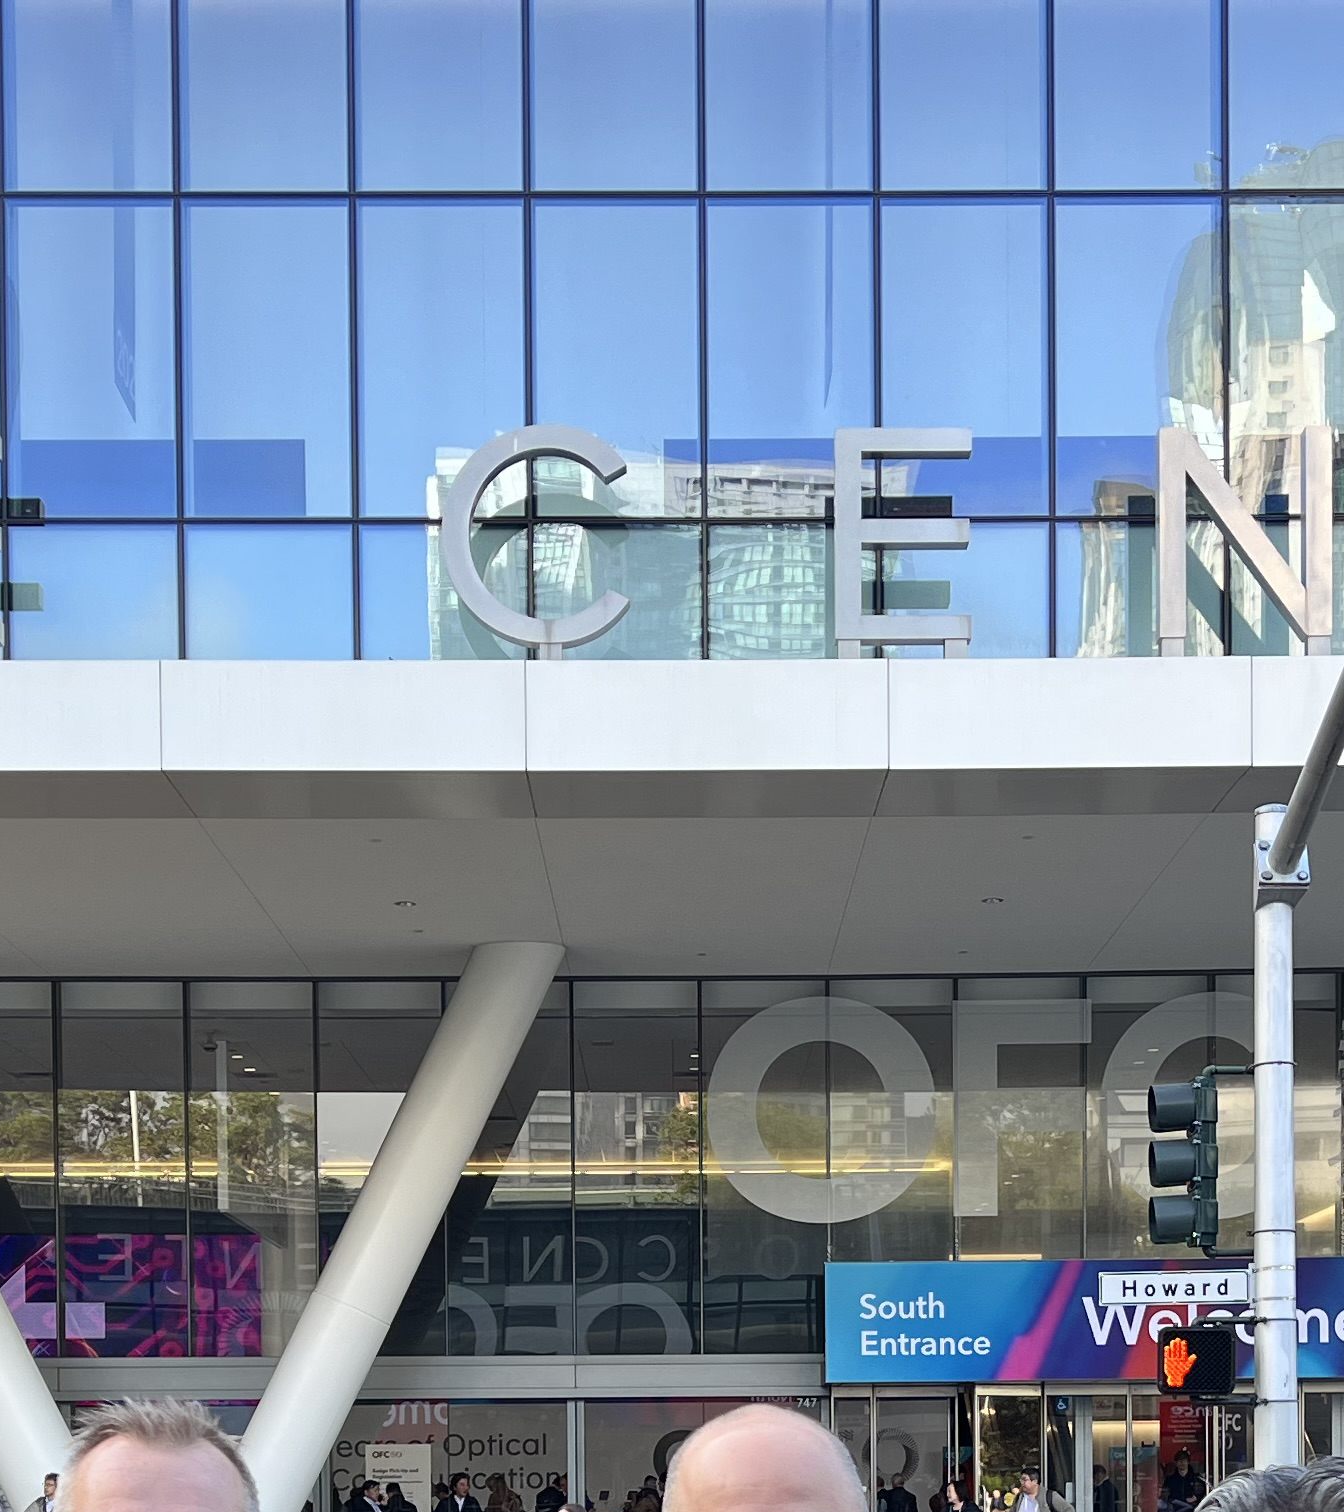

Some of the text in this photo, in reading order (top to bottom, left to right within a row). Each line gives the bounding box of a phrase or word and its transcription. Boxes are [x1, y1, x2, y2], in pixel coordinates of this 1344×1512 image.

[1122, 1278, 1229, 1298] Howard
[859, 1291, 946, 1320] South
[860, 1330, 991, 1357] Entrance
[796, 1397, 817, 1409] 747
[443, 1432, 547, 1461] Optical
